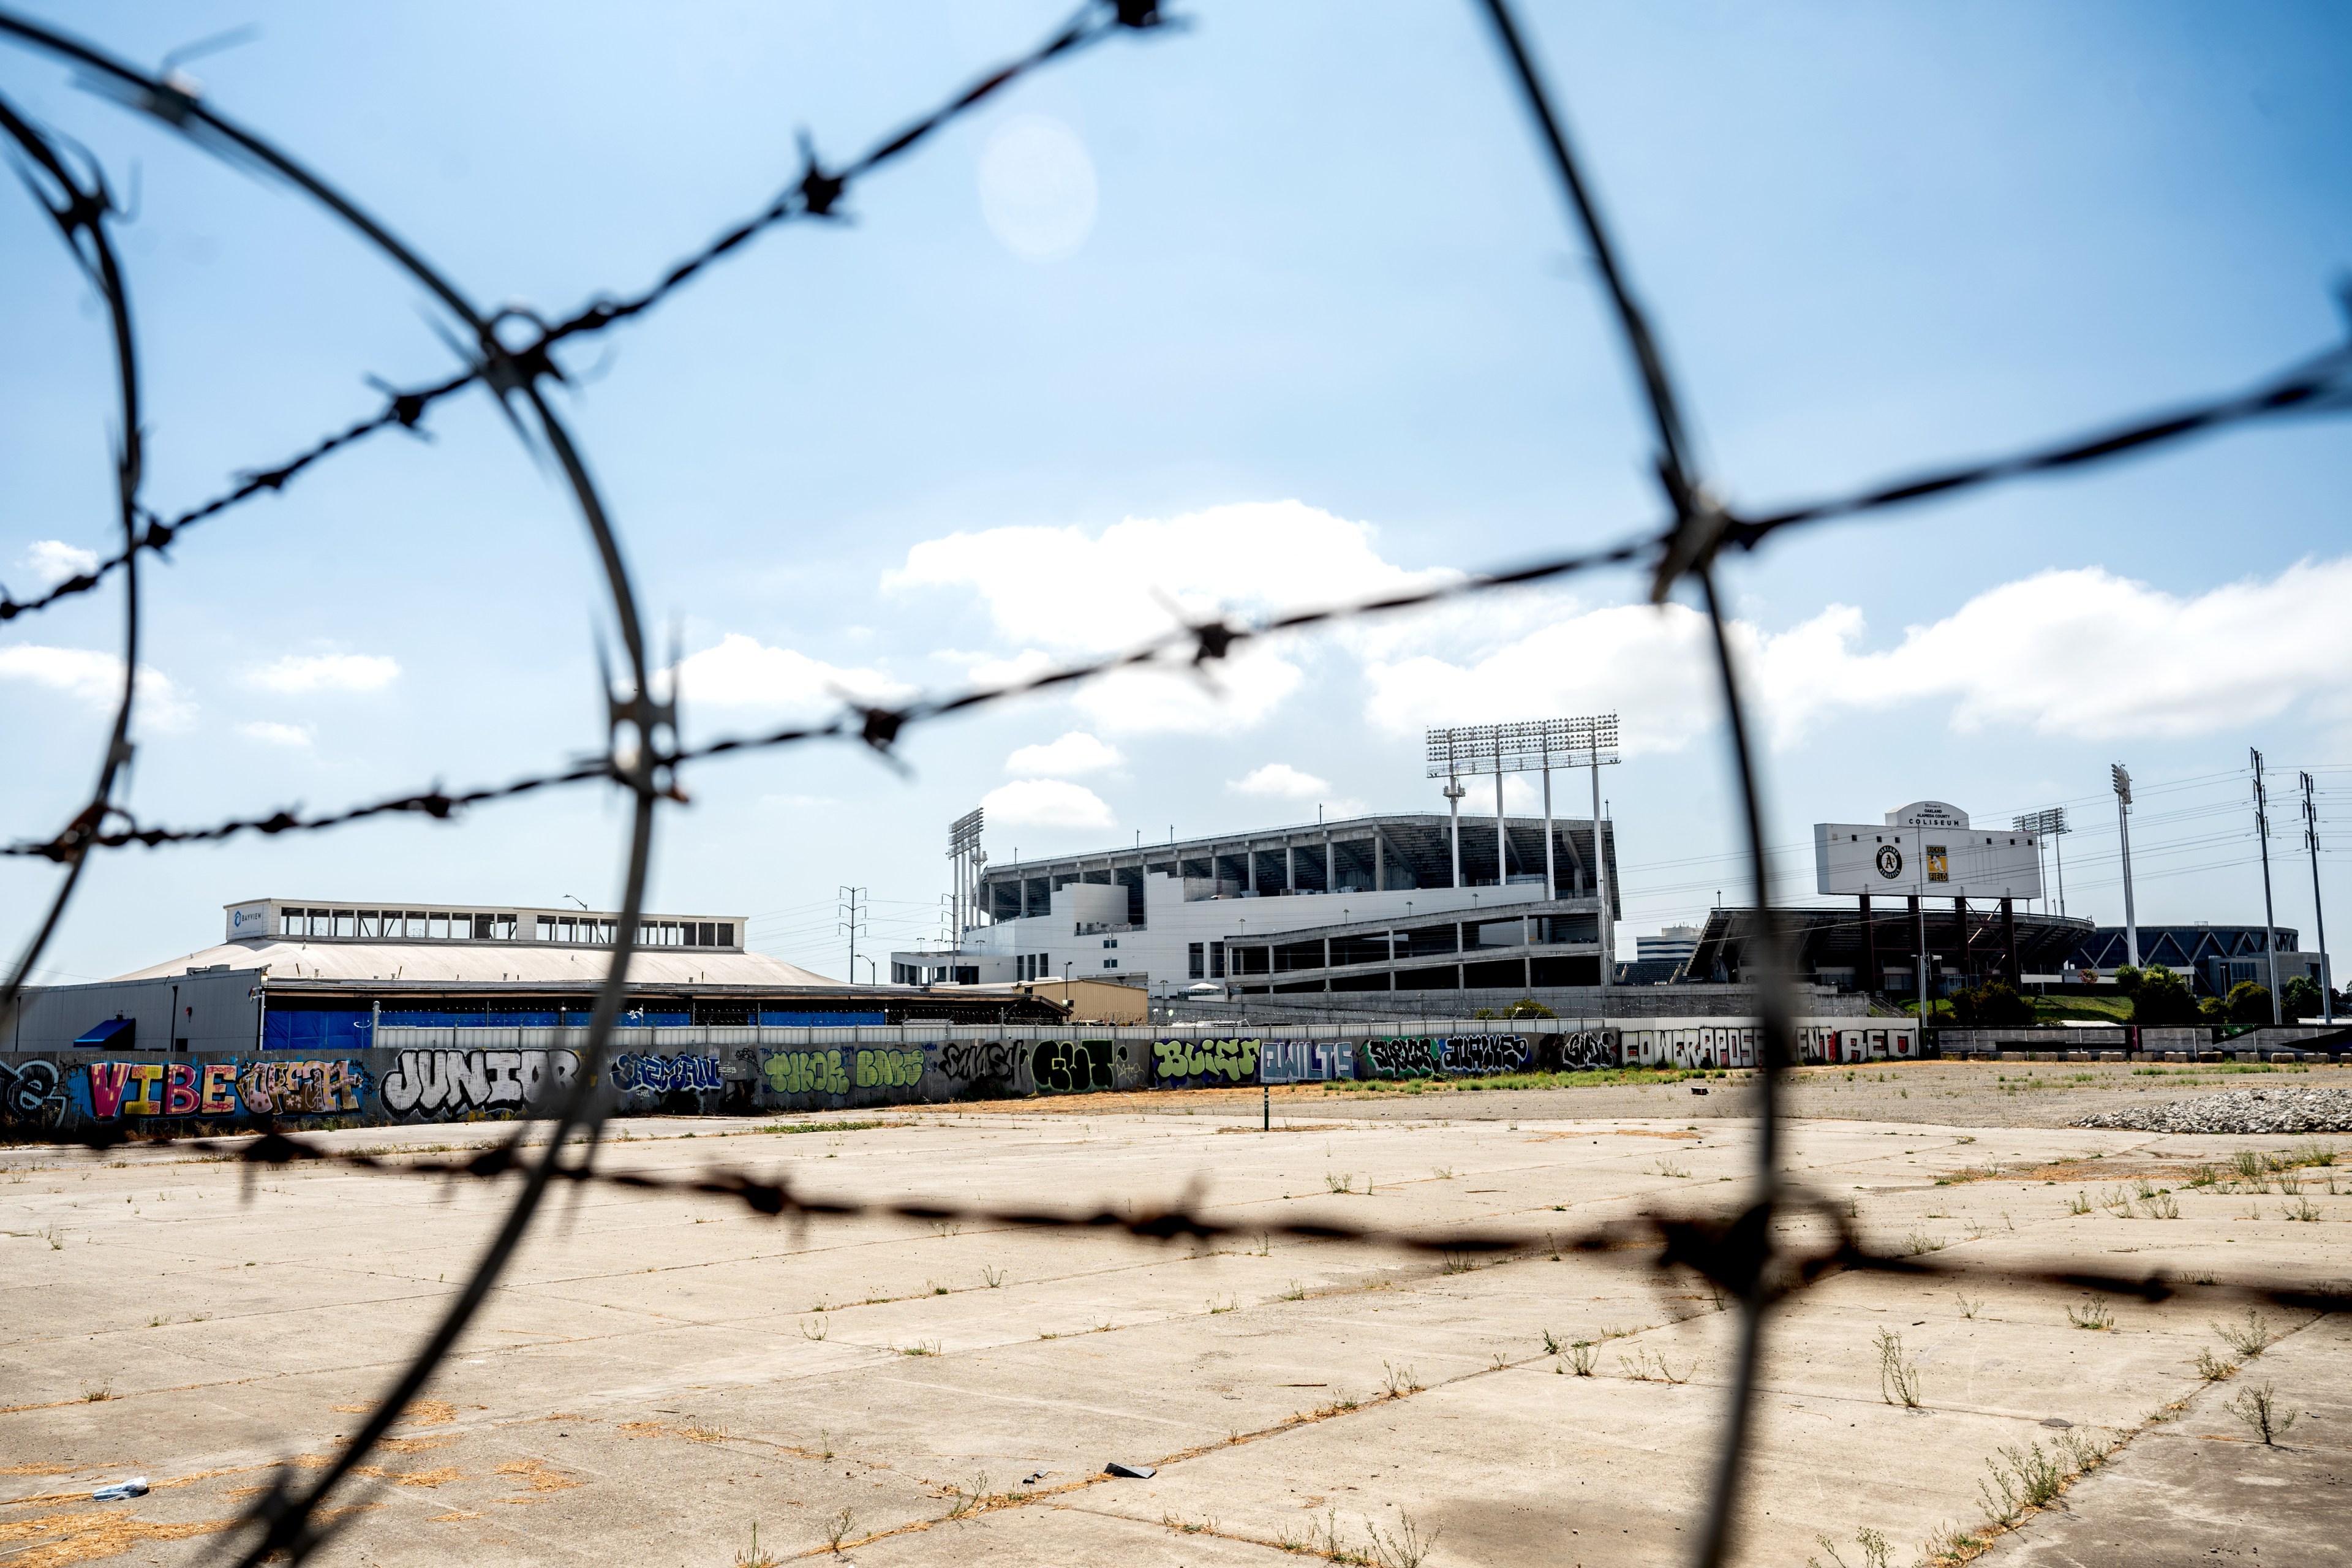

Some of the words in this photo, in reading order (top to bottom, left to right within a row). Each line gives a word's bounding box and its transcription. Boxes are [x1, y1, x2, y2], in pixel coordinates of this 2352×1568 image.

[1879, 846, 1899, 856] OAKLAND
[1880, 868, 1901, 878] ATHLETICS
[242, 913, 262, 922] BAYVIEW
[379, 1042, 582, 1114] JUNIOR
[88, 1061, 238, 1118] VIBE
